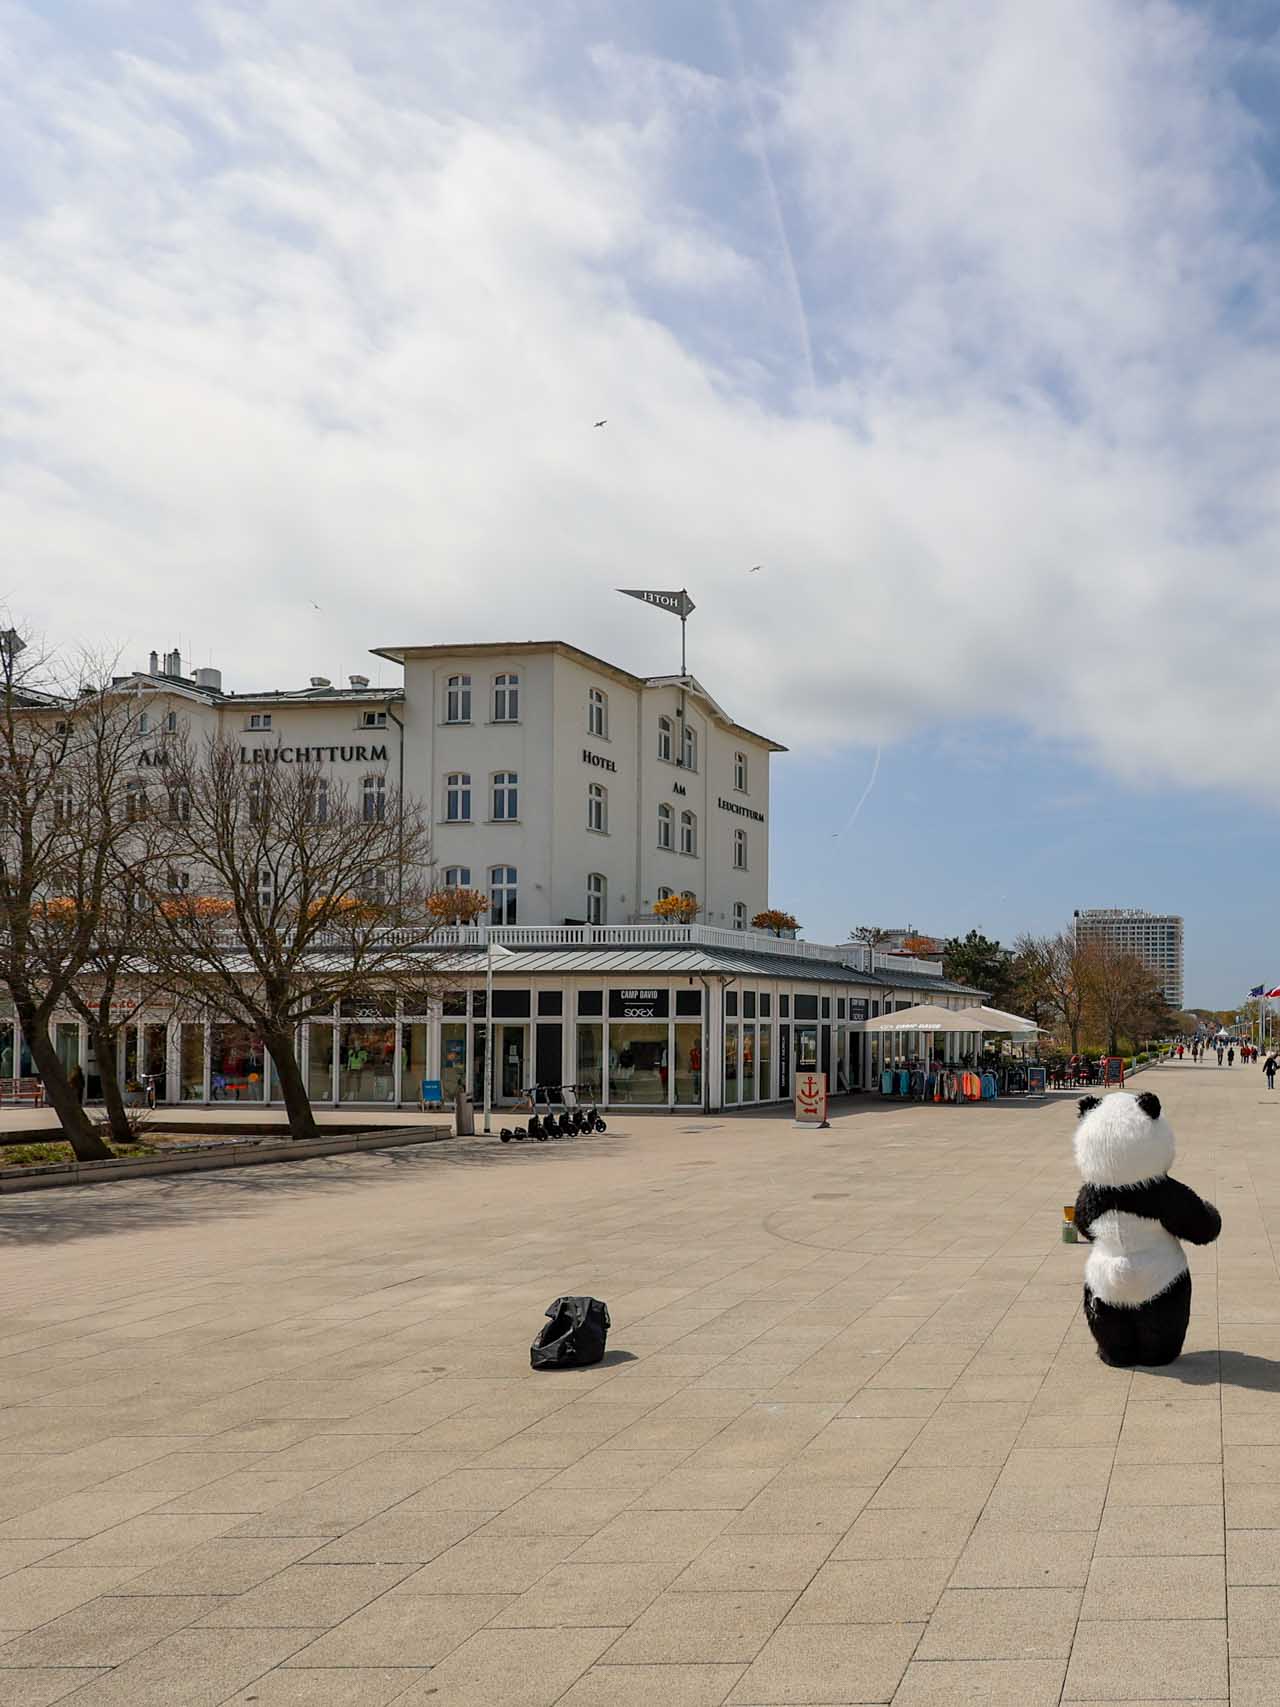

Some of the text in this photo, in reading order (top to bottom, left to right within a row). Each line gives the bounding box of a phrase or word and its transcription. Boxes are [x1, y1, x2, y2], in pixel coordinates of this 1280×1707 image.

[240, 745, 389, 764] LEUCHTTURM
[582, 749, 765, 822] HOTEL AM LEUCHTTURM
[621, 990, 658, 999] CAMP DAVID
